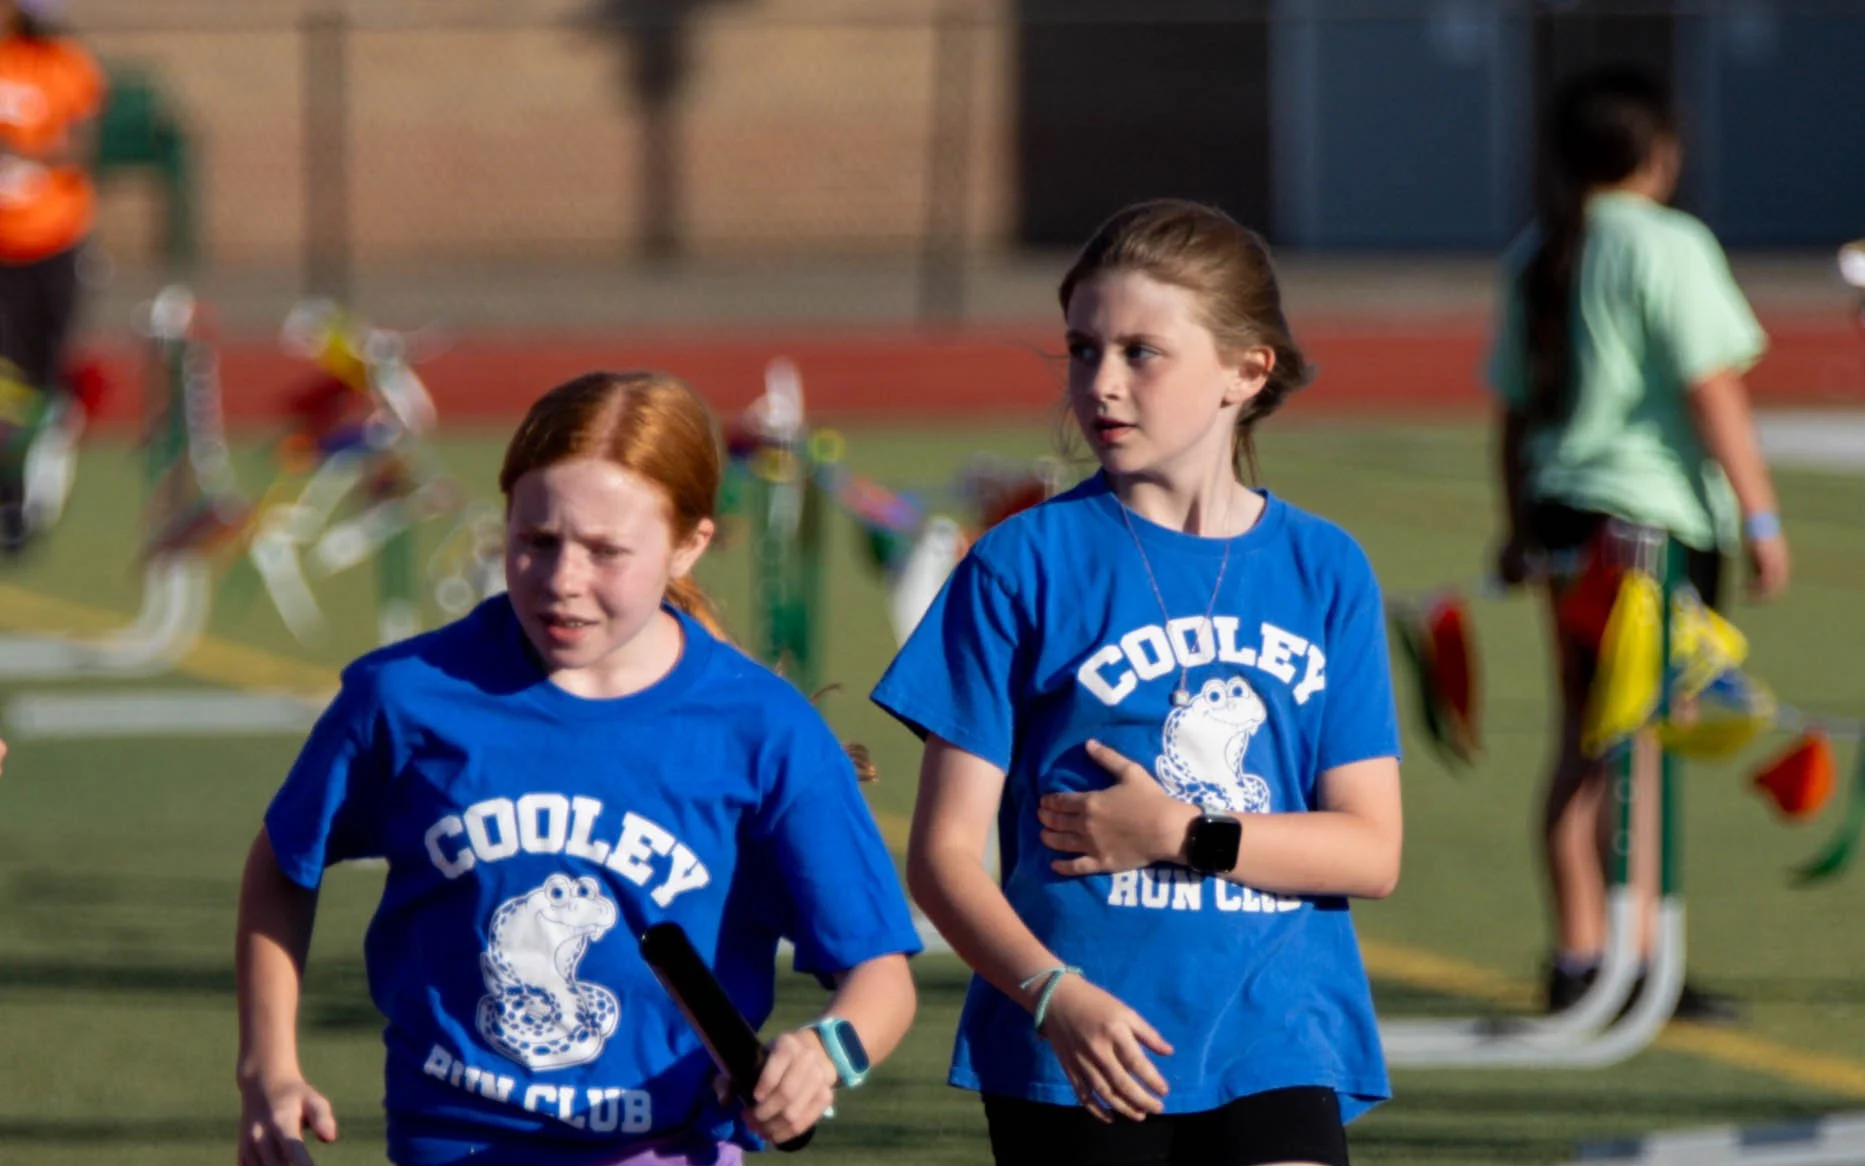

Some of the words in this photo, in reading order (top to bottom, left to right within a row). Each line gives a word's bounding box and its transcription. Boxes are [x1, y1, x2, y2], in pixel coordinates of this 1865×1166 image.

[1077, 615, 1326, 707] COOLEY
[424, 793, 711, 908] COOLEY
[1107, 869, 1202, 911] RUN
[523, 1083, 653, 1134] CLUB
